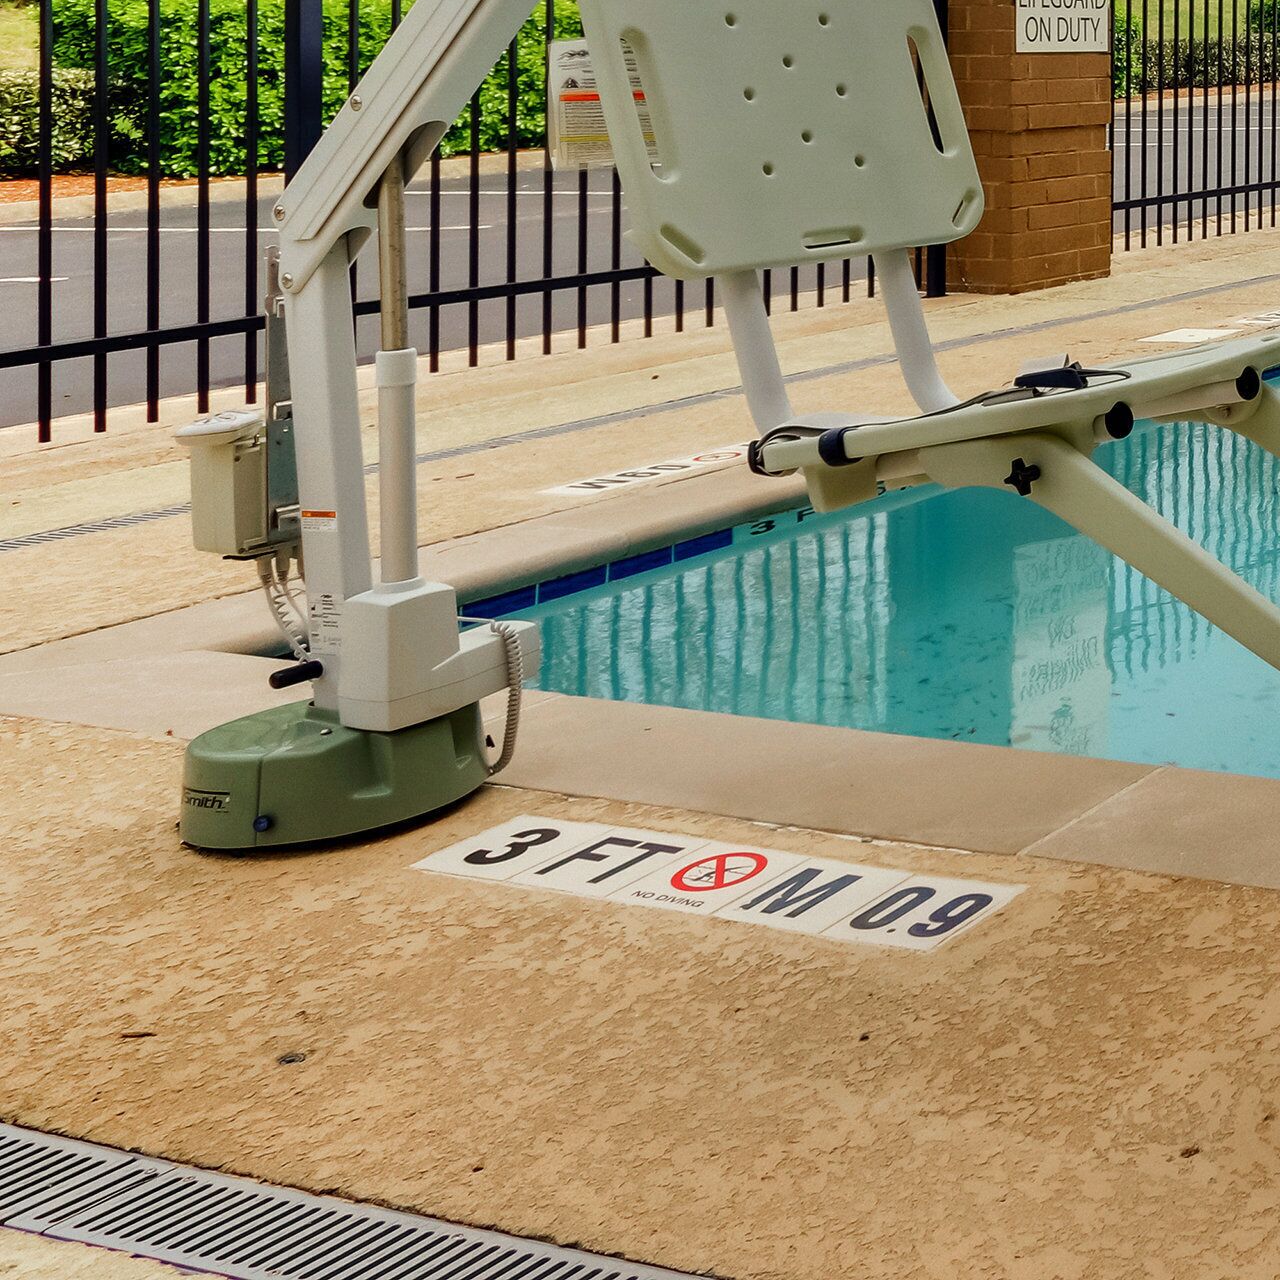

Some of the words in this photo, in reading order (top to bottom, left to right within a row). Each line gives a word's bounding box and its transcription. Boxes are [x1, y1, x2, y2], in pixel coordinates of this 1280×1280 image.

[1025, 15, 1051, 42] ON
[1057, 16, 1101, 43] DUTY
[569, 478, 634, 489] M
[750, 520, 776, 535] 3
[797, 507, 815, 523] F
[463, 828, 562, 866] 3
[534, 837, 686, 884] FT
[741, 868, 863, 919] M
[849, 886, 995, 939] 0.9
[631, 890, 655, 899] NO
[655, 895, 704, 907] DIVING
